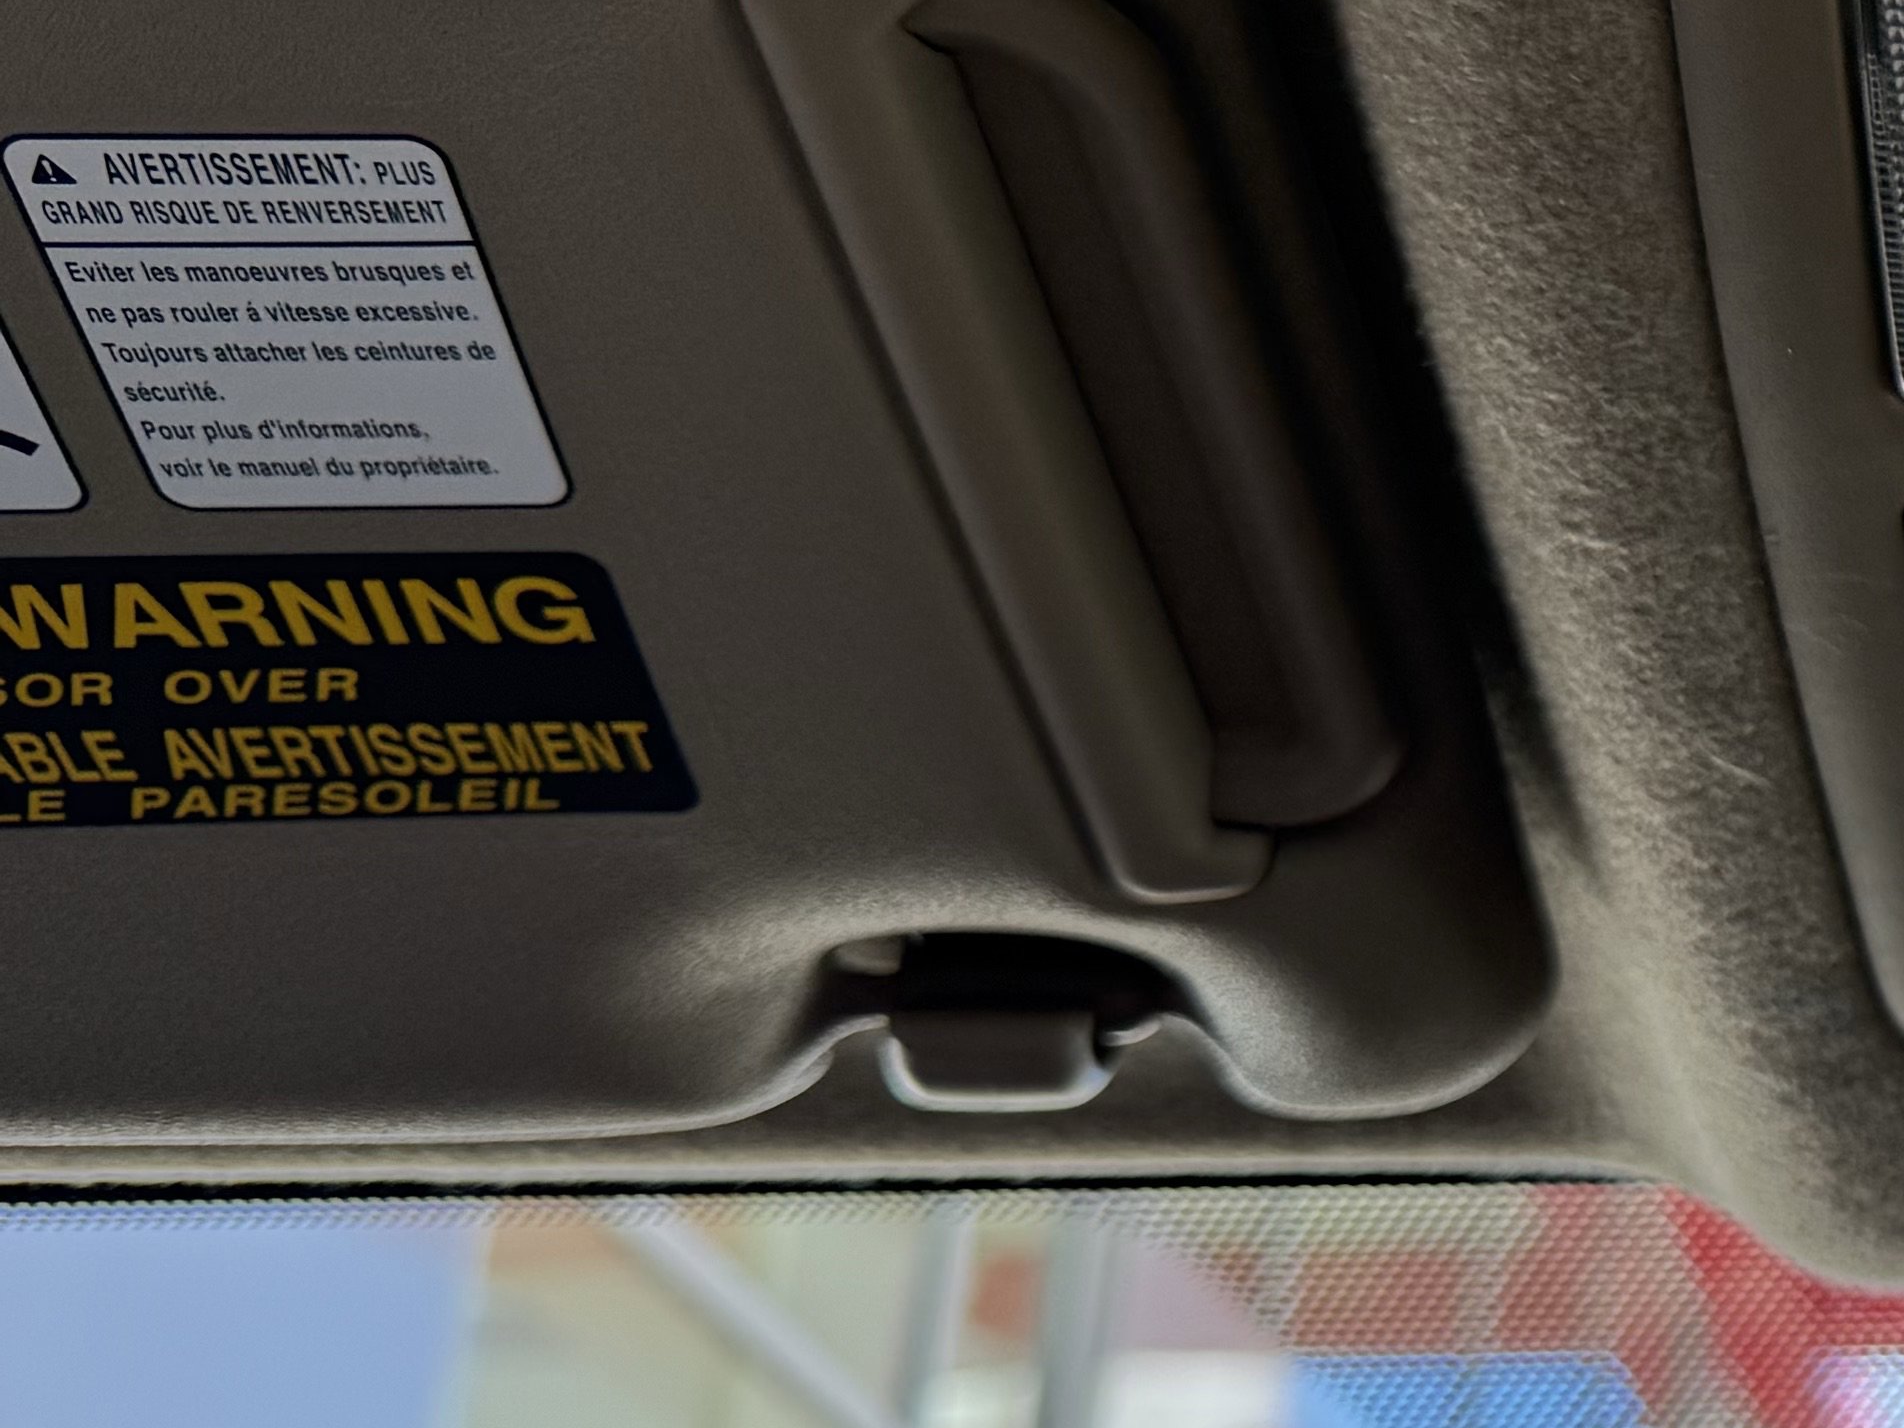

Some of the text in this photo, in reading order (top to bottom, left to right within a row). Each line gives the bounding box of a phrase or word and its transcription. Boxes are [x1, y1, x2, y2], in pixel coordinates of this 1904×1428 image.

[103, 152, 436, 186] AVERTISSEMENT: PLUS
[41, 199, 447, 226] GRAND RISQUE DE RENVERSEMENT
[65, 260, 475, 286] Eviter les manoeuvres brusques et
[86, 306, 116, 323] ne
[121, 306, 165, 328] pas
[169, 301, 239, 323] rouler
[264, 301, 350, 322] vitesse
[355, 301, 479, 322] excessive.
[101, 340, 497, 368] Toujours attacher les ceintures de
[123, 380, 226, 403] sécurité.
[140, 419, 431, 445] Pour plus d'informations,
[159, 456, 499, 481] voir le manuel du propriétaire.
[0, 668, 360, 708] OR OVER
[163, 722, 654, 781] AVERTISSEMENT
[130, 778, 561, 820] PARESOLEIL
